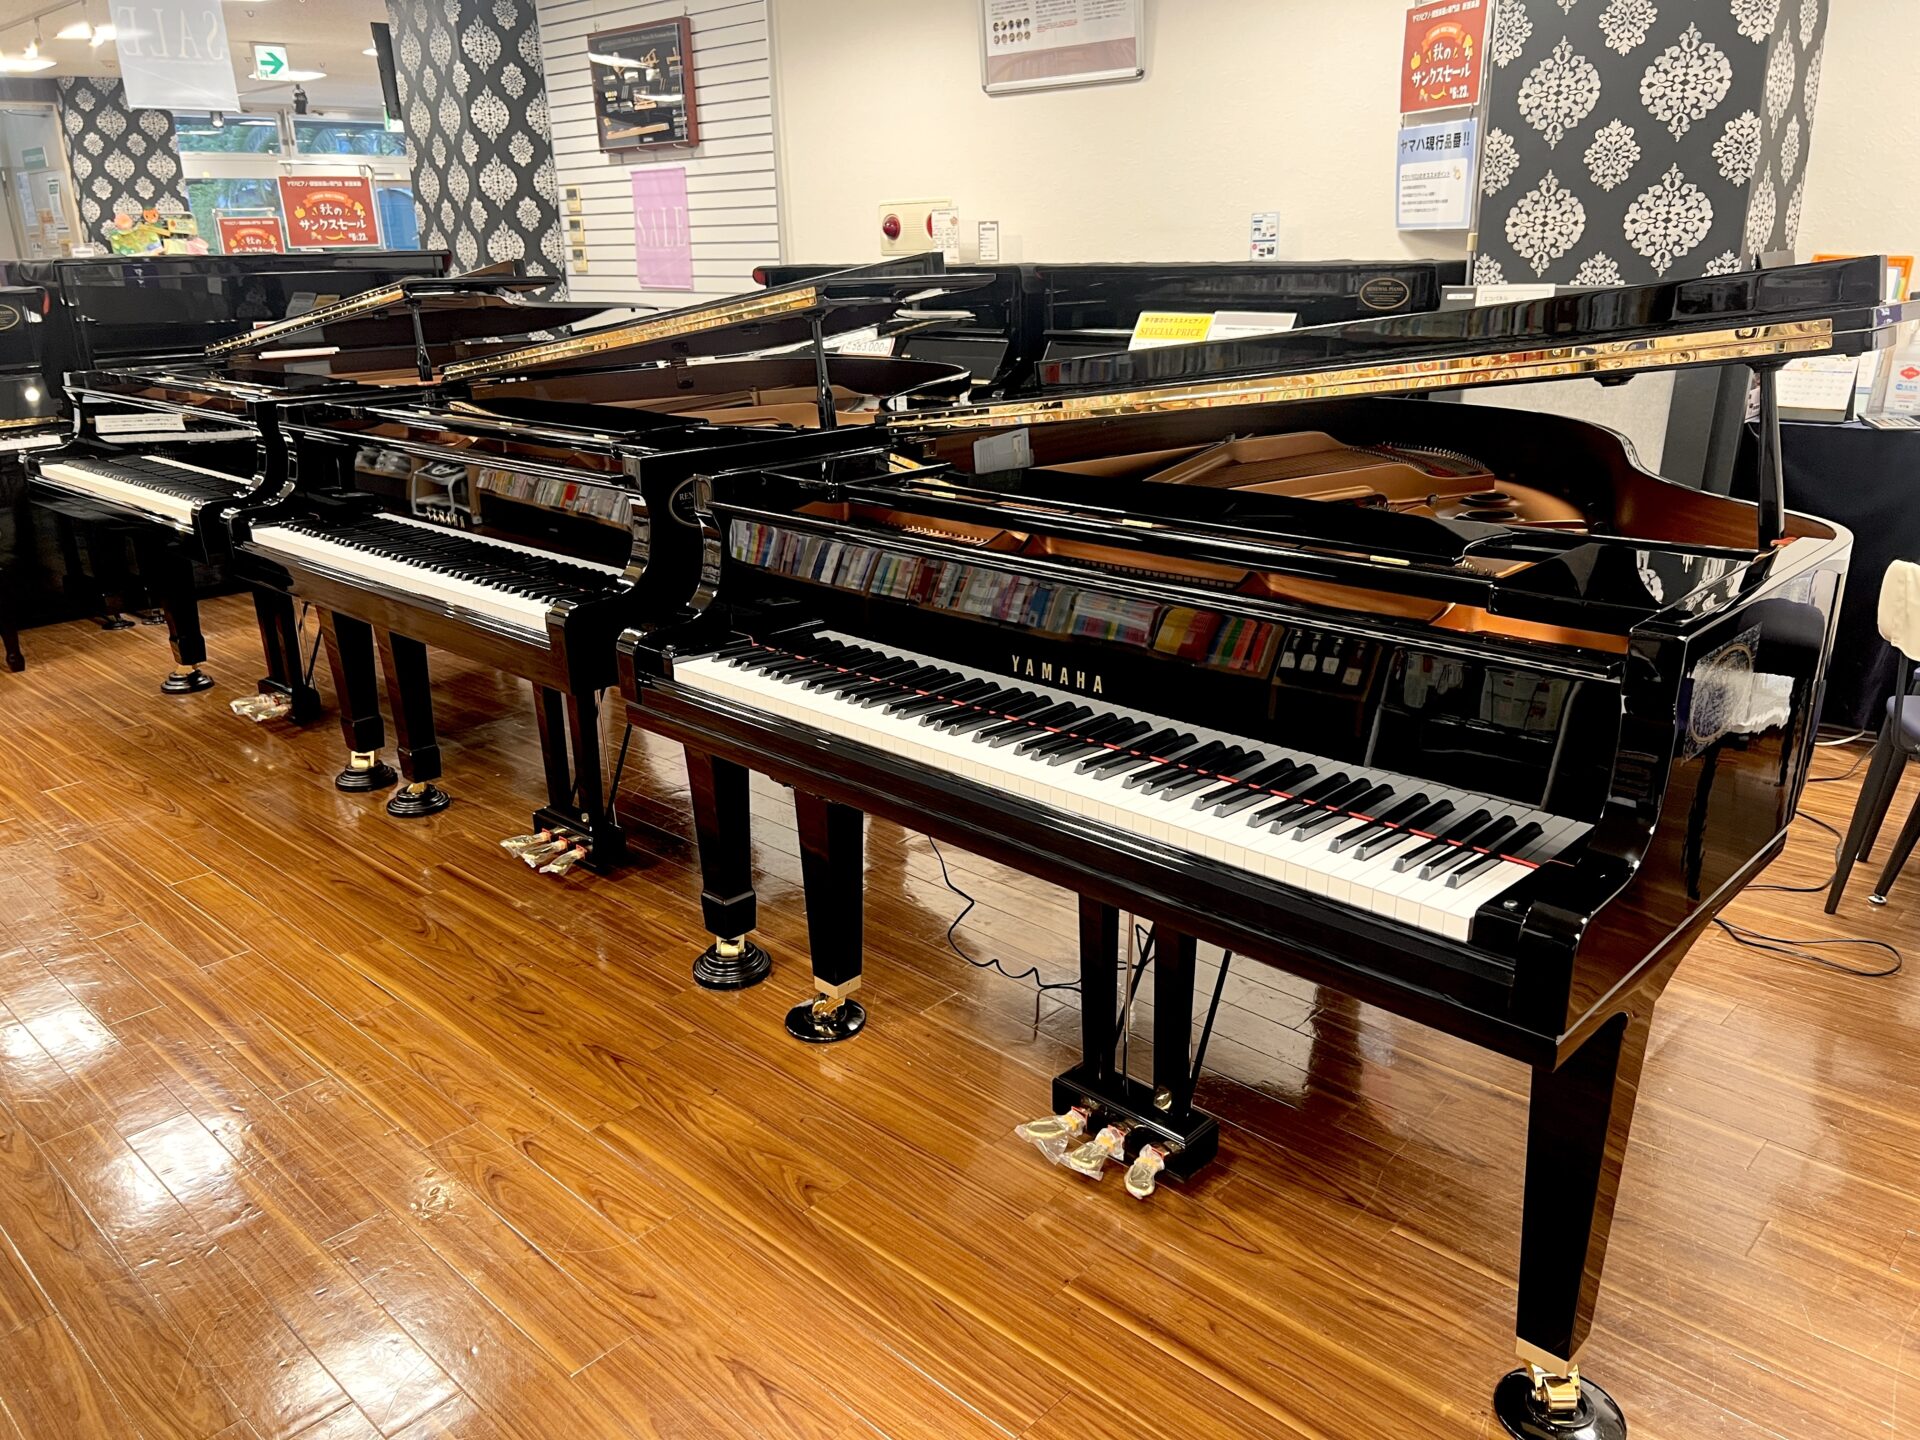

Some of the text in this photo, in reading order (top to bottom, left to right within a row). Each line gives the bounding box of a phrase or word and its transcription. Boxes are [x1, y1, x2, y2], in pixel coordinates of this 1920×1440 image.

[1433, 42, 1452, 61] 秋の
[1412, 63, 1471, 88] サンクスセール
[320, 204, 342, 216] 秋の
[299, 218, 366, 231] サンクスセール
[637, 206, 686, 248] SALE
[1139, 327, 1203, 337] SPECIAL PRICE
[1012, 654, 1102, 694] YAMAHA
